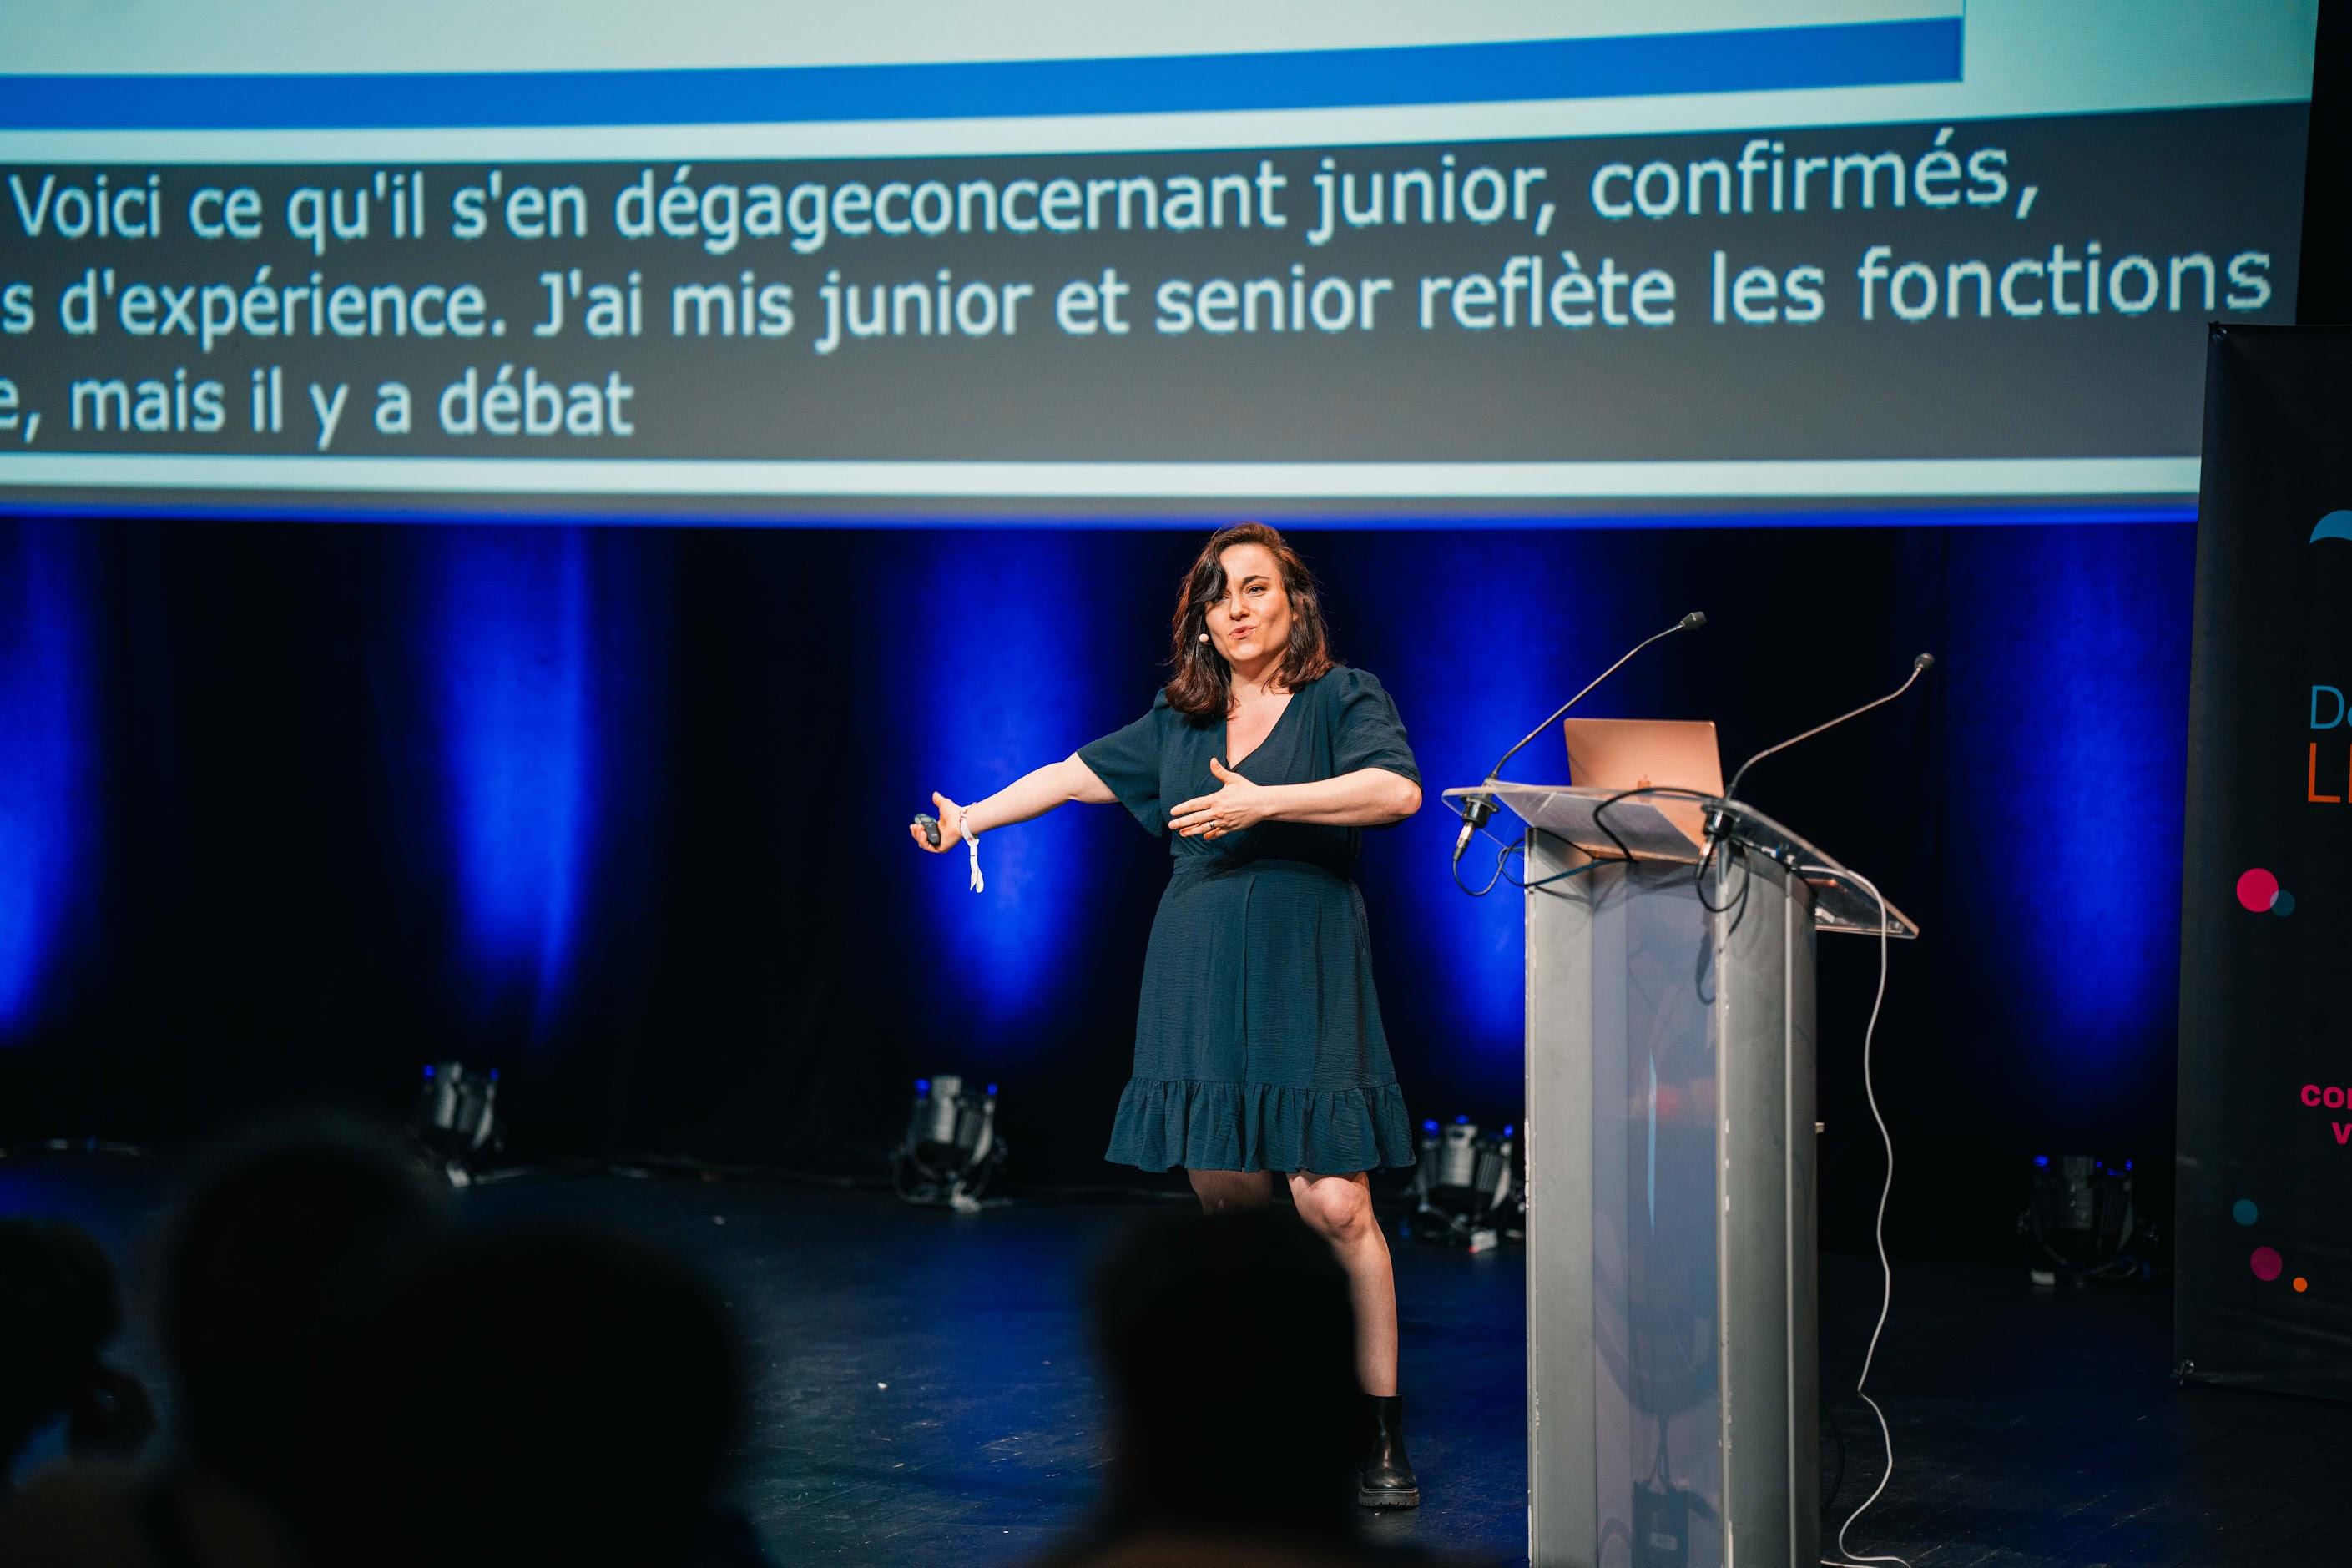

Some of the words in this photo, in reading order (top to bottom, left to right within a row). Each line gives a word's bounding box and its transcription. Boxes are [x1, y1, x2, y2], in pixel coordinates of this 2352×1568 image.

[9, 173, 160, 239] Voici
[189, 187, 263, 240] ce
[286, 169, 425, 256] qu'il
[452, 169, 588, 239] s'en
[614, 159, 1289, 255] dégageconcernant
[1305, 155, 1557, 248] junior,
[1590, 125, 2039, 221] confirmés,
[59, 265, 507, 355] d'expérience.
[532, 268, 643, 338] J'ai
[671, 269, 795, 340] mis
[812, 267, 1037, 357] junior
[1054, 266, 1132, 338] et
[1153, 262, 1396, 335] senior
[1418, 249, 1678, 331] reflète
[1711, 249, 1826, 325] les
[1855, 239, 2274, 322] fonctions
[71, 367, 226, 432] mais
[252, 365, 284, 433] il
[308, 382, 349, 451] y
[373, 381, 412, 435] a
[437, 362, 637, 438] débat
[2310, 684, 2352, 729] D
[2308, 742, 2352, 804] L
